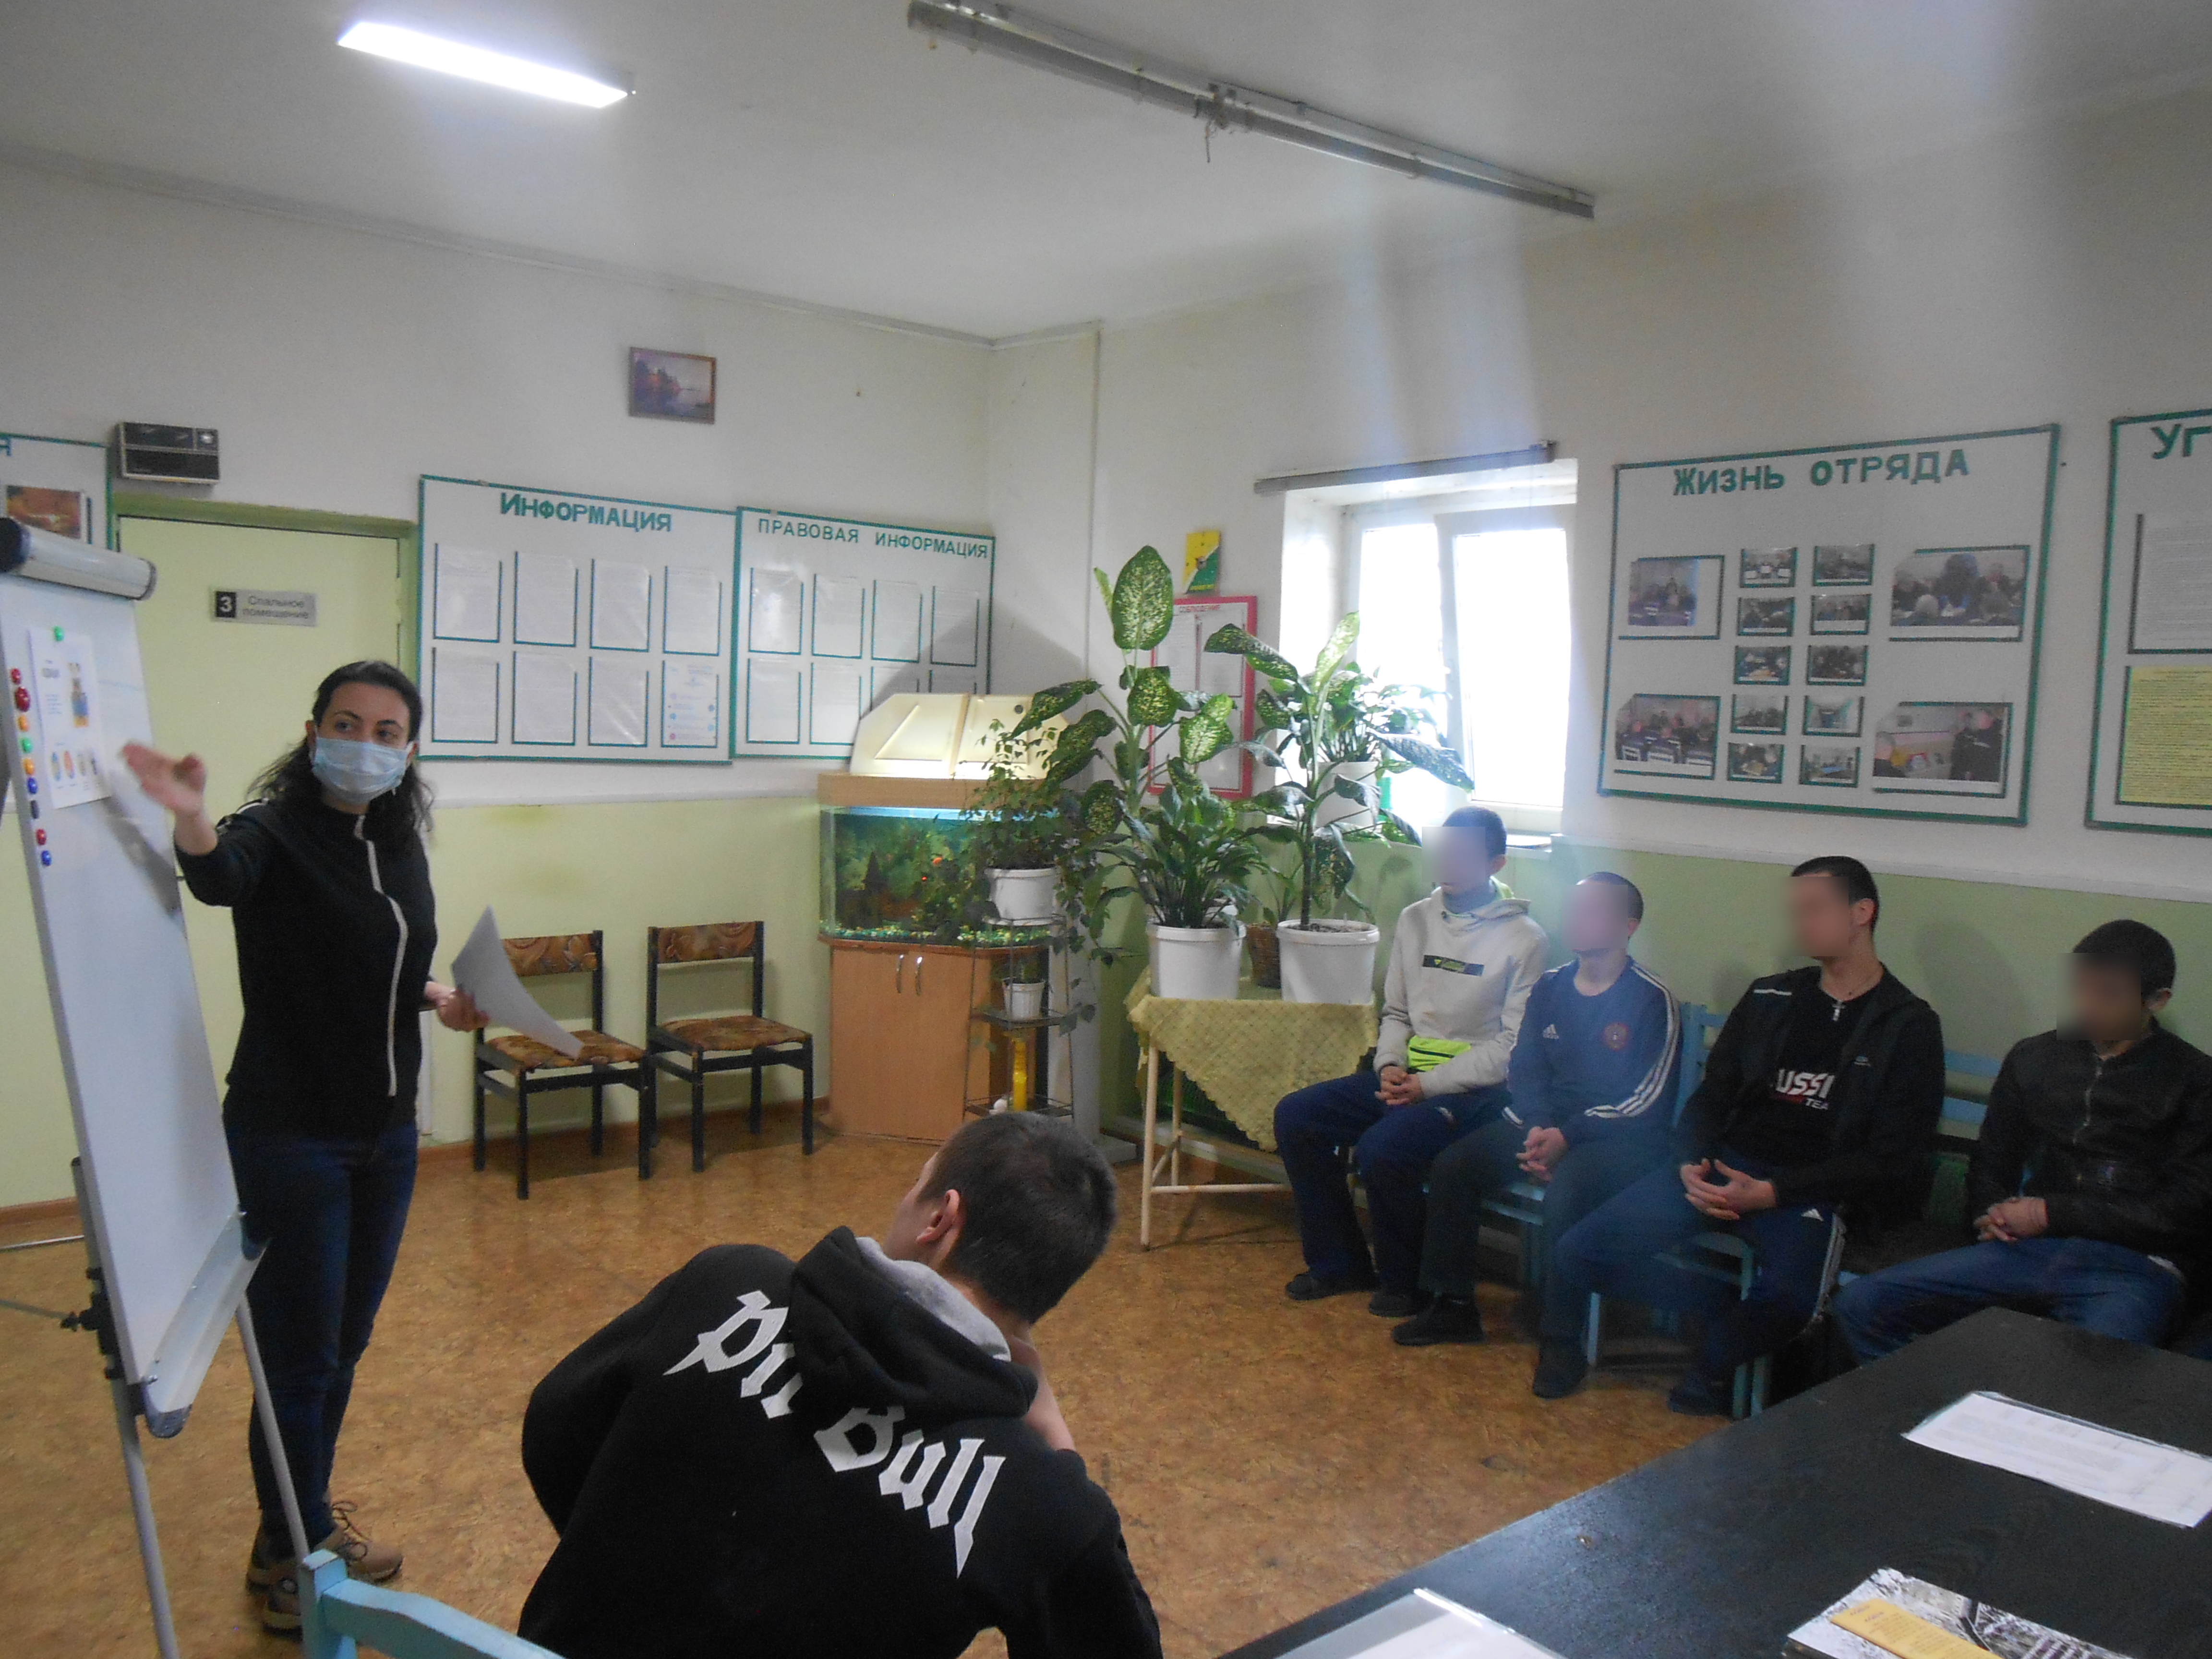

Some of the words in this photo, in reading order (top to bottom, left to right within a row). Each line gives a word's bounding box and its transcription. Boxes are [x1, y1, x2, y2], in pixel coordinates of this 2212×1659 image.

[1673, 465, 1785, 496] ЖИЗНЬ
[1810, 449, 1970, 486] ОТРЯДА
[501, 492, 672, 532] ИНФОРМАЦИЯ
[758, 518, 859, 543] ПРАВОВАЯ
[875, 532, 988, 559] ИНФОРМАЦИЯ
[219, 596, 232, 613] 3
